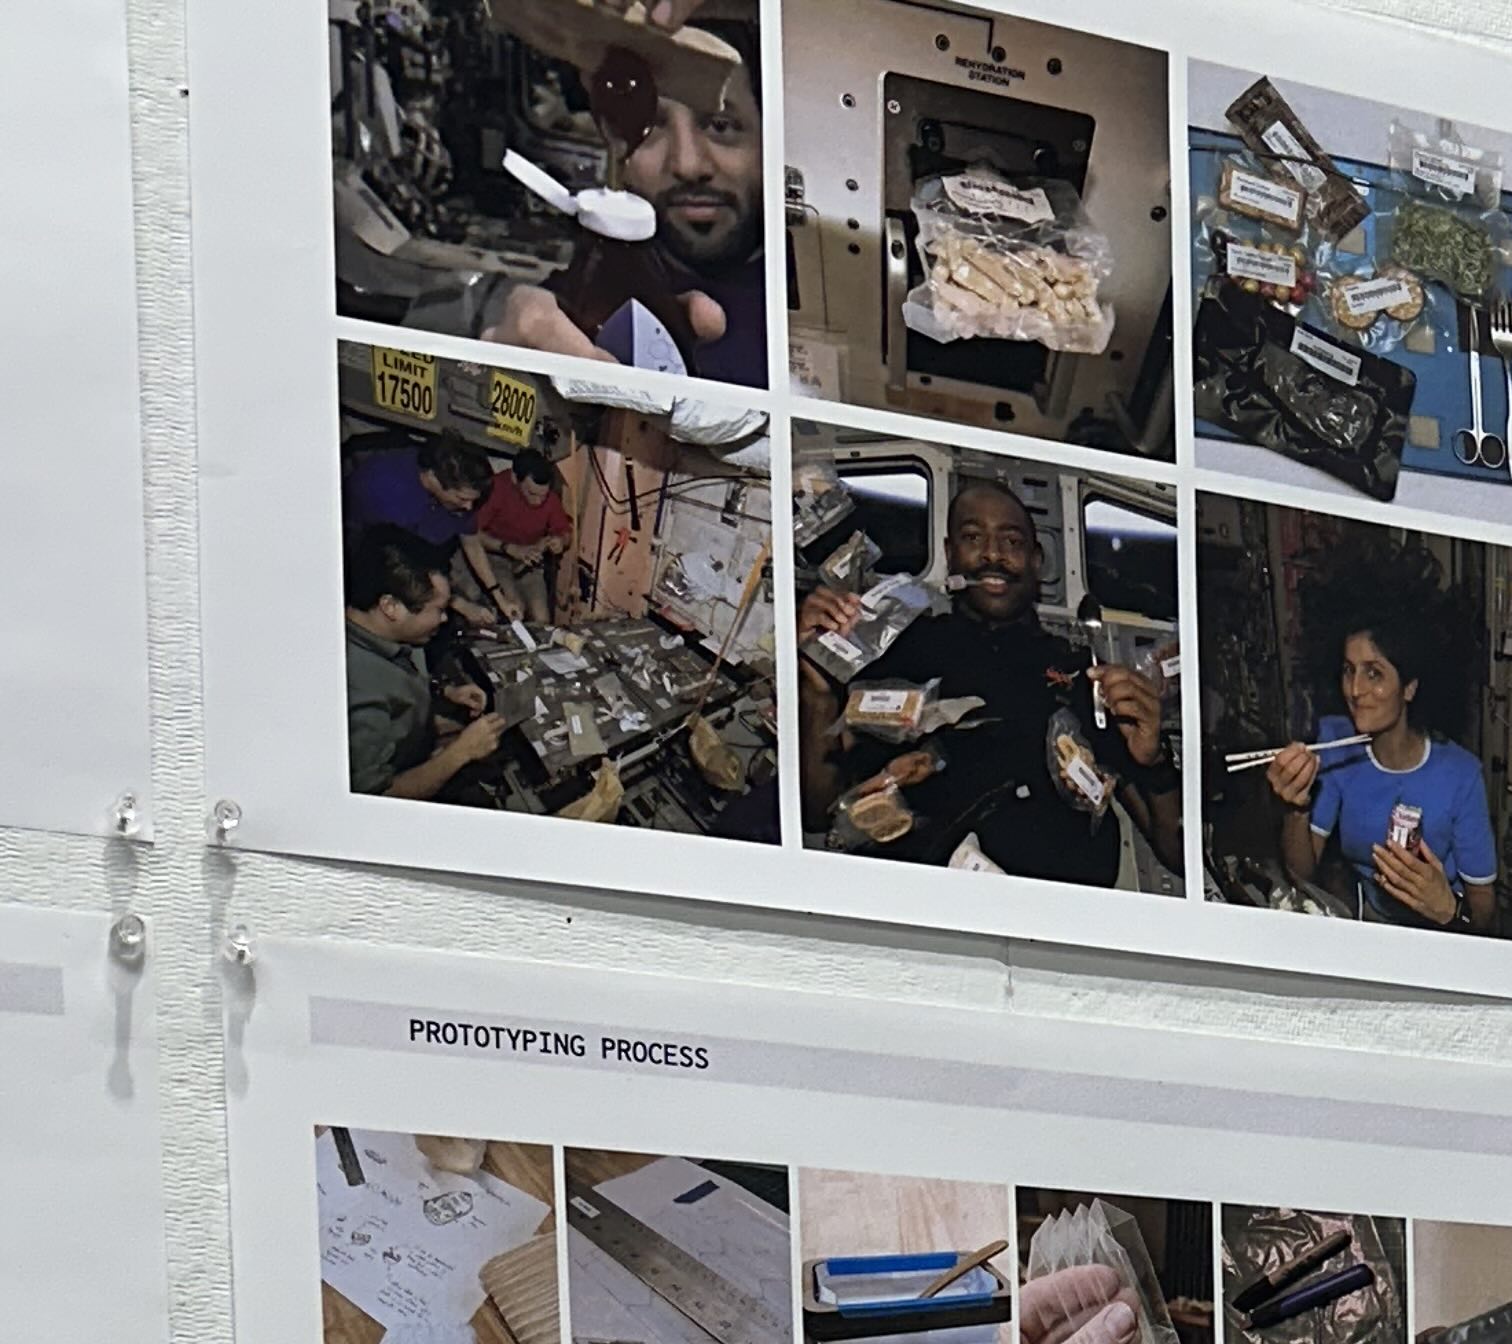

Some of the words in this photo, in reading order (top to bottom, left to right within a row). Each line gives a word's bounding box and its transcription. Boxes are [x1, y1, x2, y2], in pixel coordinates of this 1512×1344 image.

[383, 352, 428, 379] LIMIT
[377, 370, 433, 415] 17500
[491, 380, 535, 425] 28000
[409, 1018, 586, 1057] PROTOTYPING
[601, 1037, 709, 1069] PROCESS
